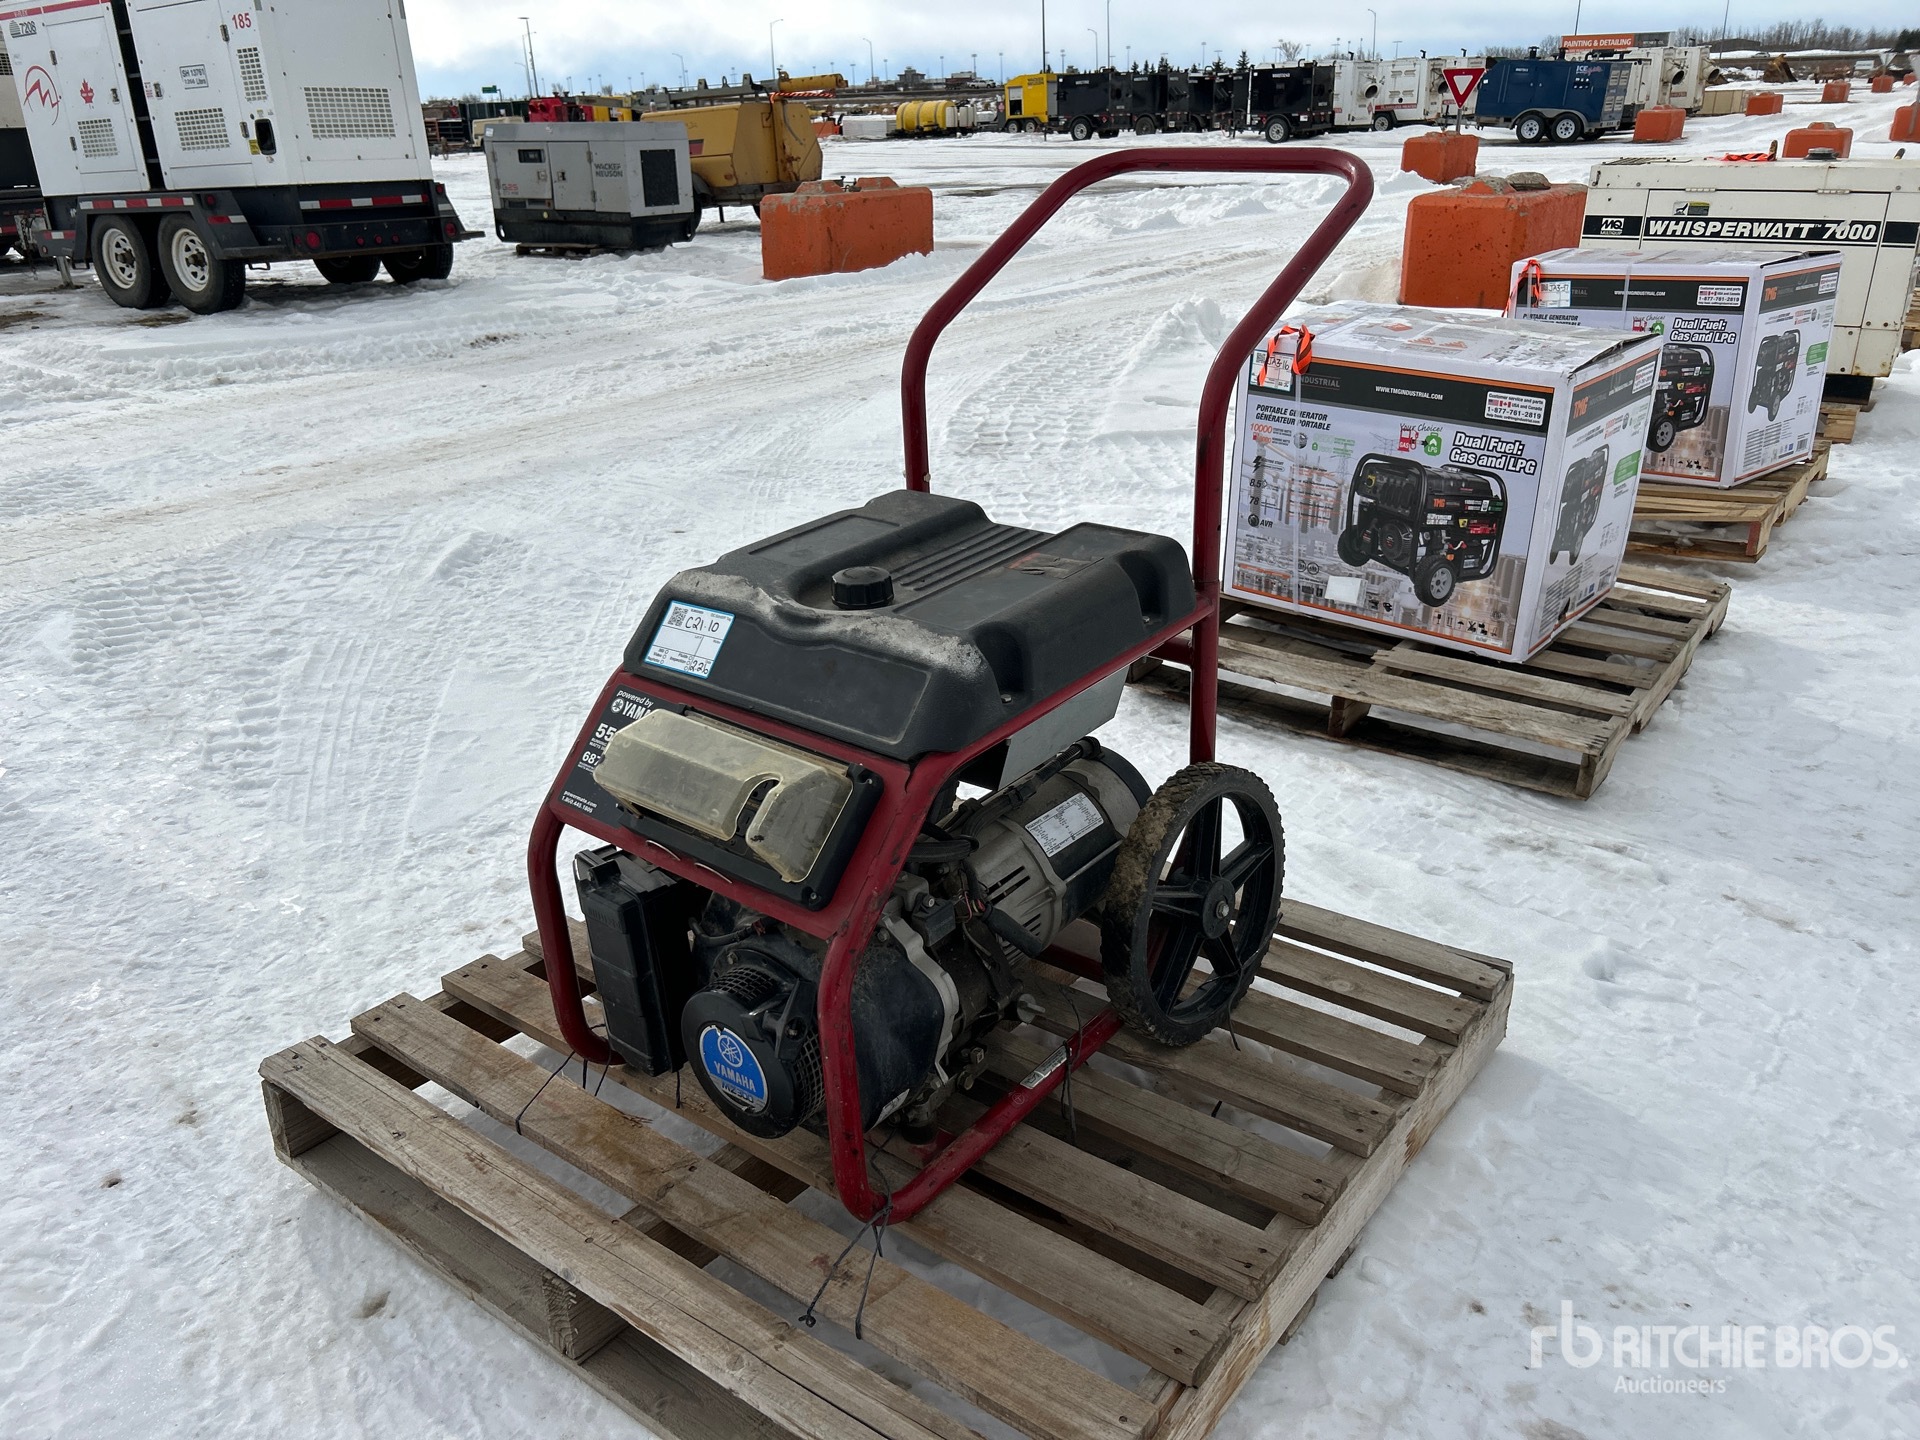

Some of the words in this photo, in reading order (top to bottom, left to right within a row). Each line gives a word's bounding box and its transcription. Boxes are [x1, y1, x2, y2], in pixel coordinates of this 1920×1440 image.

[232, 12, 252, 30] 185
[1564, 40, 1592, 48] PAINTING
[1599, 38, 1632, 46] DETAILING
[1601, 218, 1624, 229] MQ
[1650, 220, 1815, 238] WHISPERWATT
[1823, 222, 1877, 240] 7000
[1674, 318, 1697, 330] Dual
[1699, 319, 1727, 330] Fuel:
[1670, 330, 1690, 342] Gas
[1692, 331, 1713, 342] and
[1713, 332, 1736, 343] LPG
[1300, 376, 1340, 387] NDUSTRIAL
[1375, 386, 1443, 400] WWW.TMGINDUSTRIAL.COM
[1256, 404, 1288, 415] PORTABLE
[1488, 407, 1541, 419] 1-877-761-2819
[1256, 413, 1295, 426] GÉNÉRATEUR
[1251, 423, 1272, 434] 10000
[1418, 423, 1443, 432] Choice!
[1453, 431, 1487, 447] Dual
[1488, 436, 1525, 456] Fuel:
[1450, 448, 1476, 464] Gas
[1477, 453, 1507, 469] and
[1506, 457, 1537, 474] LPG
[1250, 478, 1261, 487] 8.5
[1250, 496, 1259, 505] 78
[1260, 519, 1273, 528] AVR
[617, 690, 646, 704] powered
[644, 699, 654, 708] by
[622, 701, 651, 720] YAM
[582, 751, 601, 766] 687
[714, 1061, 756, 1092] YAMAHA
